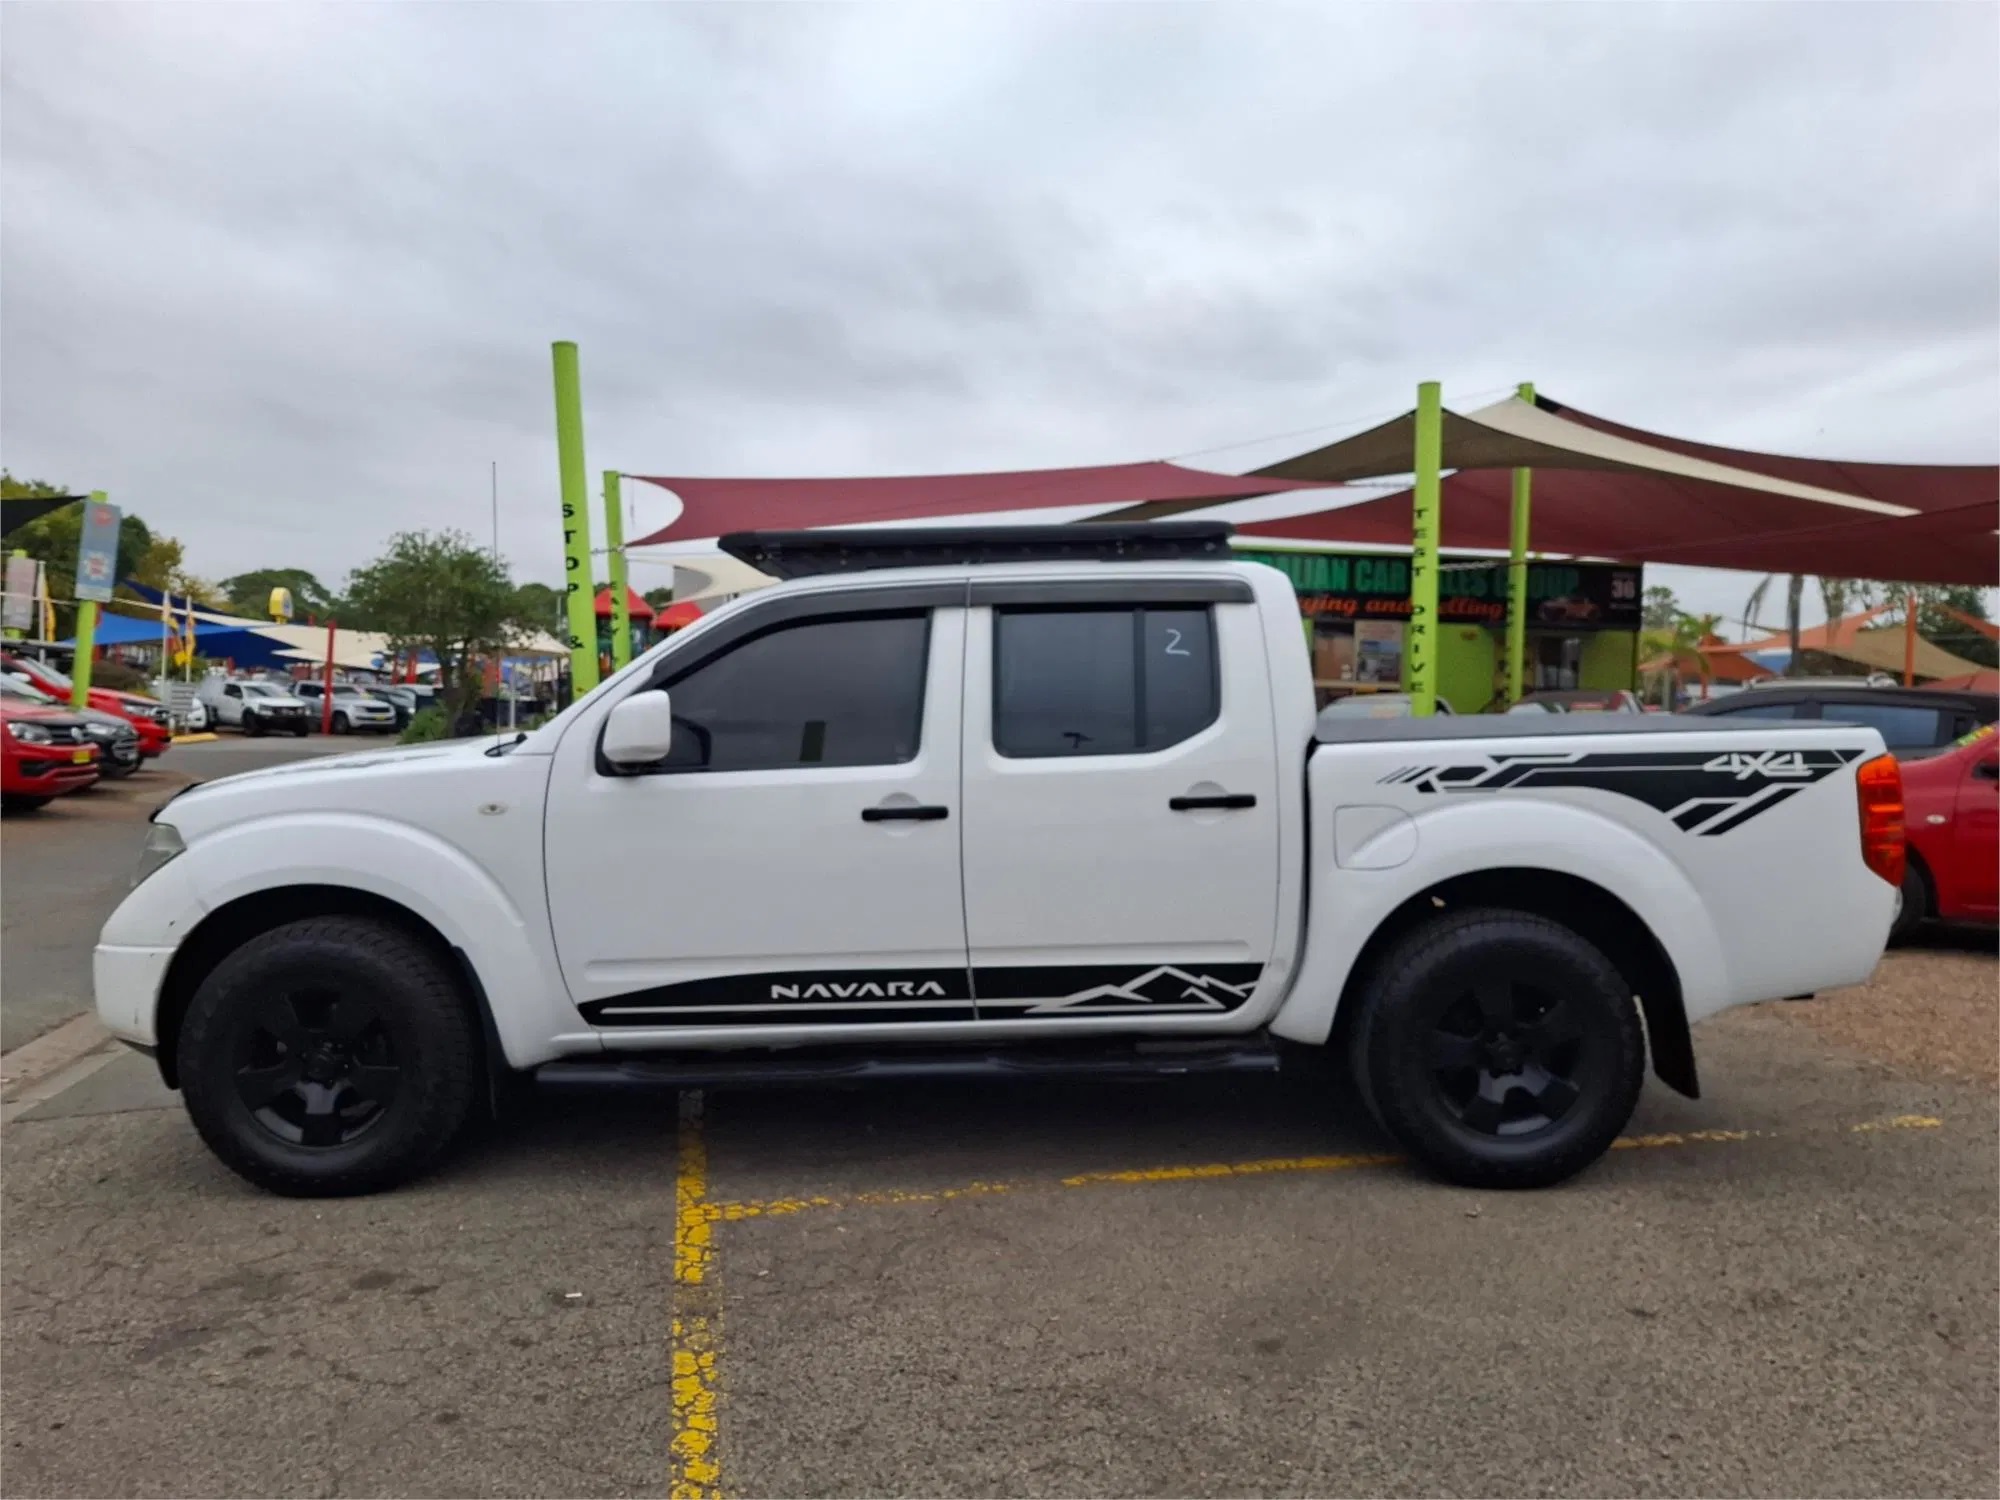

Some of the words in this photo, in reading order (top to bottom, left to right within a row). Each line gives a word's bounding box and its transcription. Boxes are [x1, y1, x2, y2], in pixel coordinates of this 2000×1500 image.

[562, 503, 580, 592] STOP
[1412, 507, 1428, 577] TEST
[1354, 558, 1407, 594] CAR
[570, 635, 585, 650] &
[1165, 628, 1190, 656] 2
[1410, 605, 1426, 693] DRIVE
[771, 981, 946, 999] NAVARA
